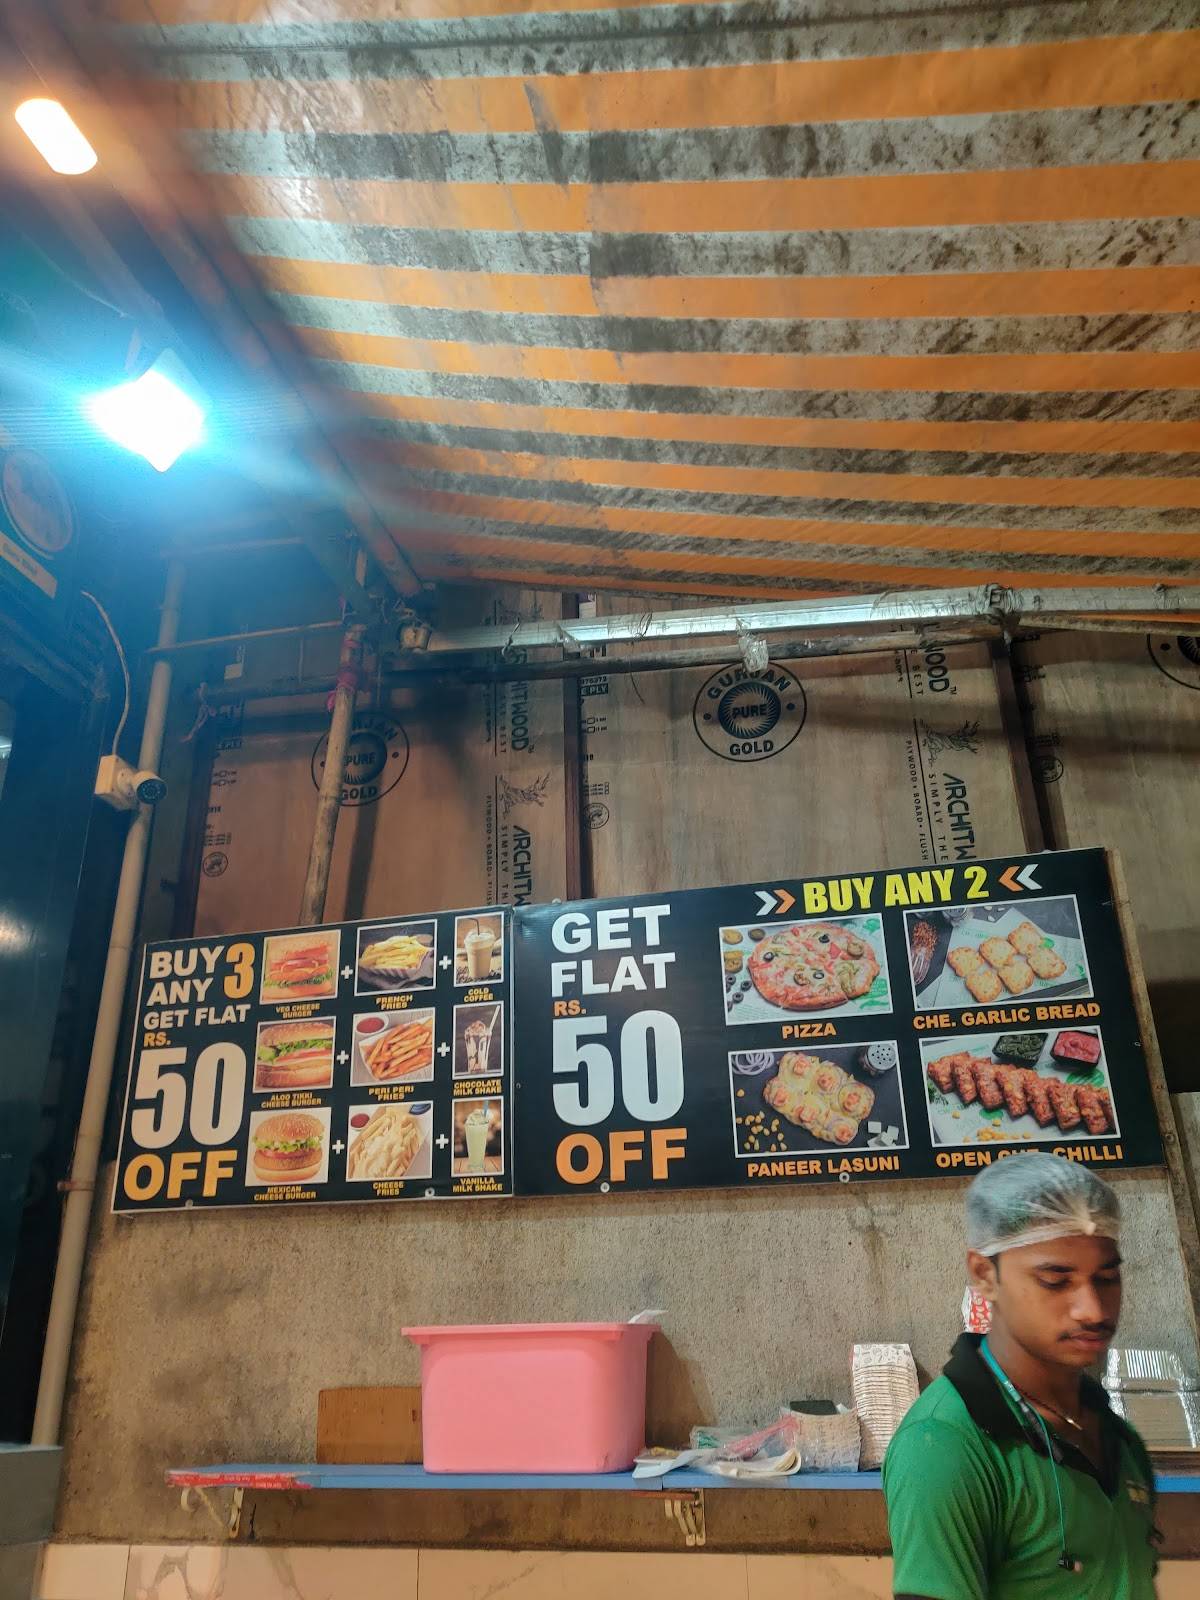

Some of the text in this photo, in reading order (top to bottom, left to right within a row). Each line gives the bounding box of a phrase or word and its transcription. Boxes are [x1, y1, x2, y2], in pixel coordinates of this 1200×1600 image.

[732, 704, 768, 719] PURE
[729, 740, 774, 756] GOLD
[906, 740, 929, 861] PLYWOOD BOARD FLUSH
[928, 773, 949, 861] SIMPLY THE
[501, 825, 509, 873] SIMPLY
[803, 865, 990, 915] BUY ANY 2
[551, 904, 671, 954] GET
[149, 942, 256, 999] BUY 3
[551, 952, 676, 998] FLAT
[146, 977, 214, 1007] ANY
[376, 995, 413, 1004] FRENCH
[464, 993, 493, 1002] COFFEE
[468, 987, 490, 996] COLD
[143, 1004, 251, 1030] GET FLAT
[554, 999, 587, 1017] RS.
[912, 1002, 1101, 1030] CHE. GARLIC BREAD
[143, 1031, 171, 1047] RS.
[781, 1021, 837, 1040] PIZZA
[552, 1009, 685, 1126] 50
[368, 1085, 415, 1095] PERI PERI
[453, 1079, 502, 1089] CHOCOLATE
[453, 1086, 502, 1096] MILK SHAKE
[131, 1042, 247, 1149] 50
[271, 1092, 313, 1102] ALOO TIKKI
[555, 1127, 688, 1185] OFF
[935, 1151, 992, 1168] OPEN
[123, 1150, 238, 1201] OFF
[747, 1155, 900, 1178] PANEER LASUNI
[267, 1186, 302, 1194] MEXICAN
[452, 1183, 503, 1193] MILK SHAKE
[460, 1177, 495, 1185] VANILLA
